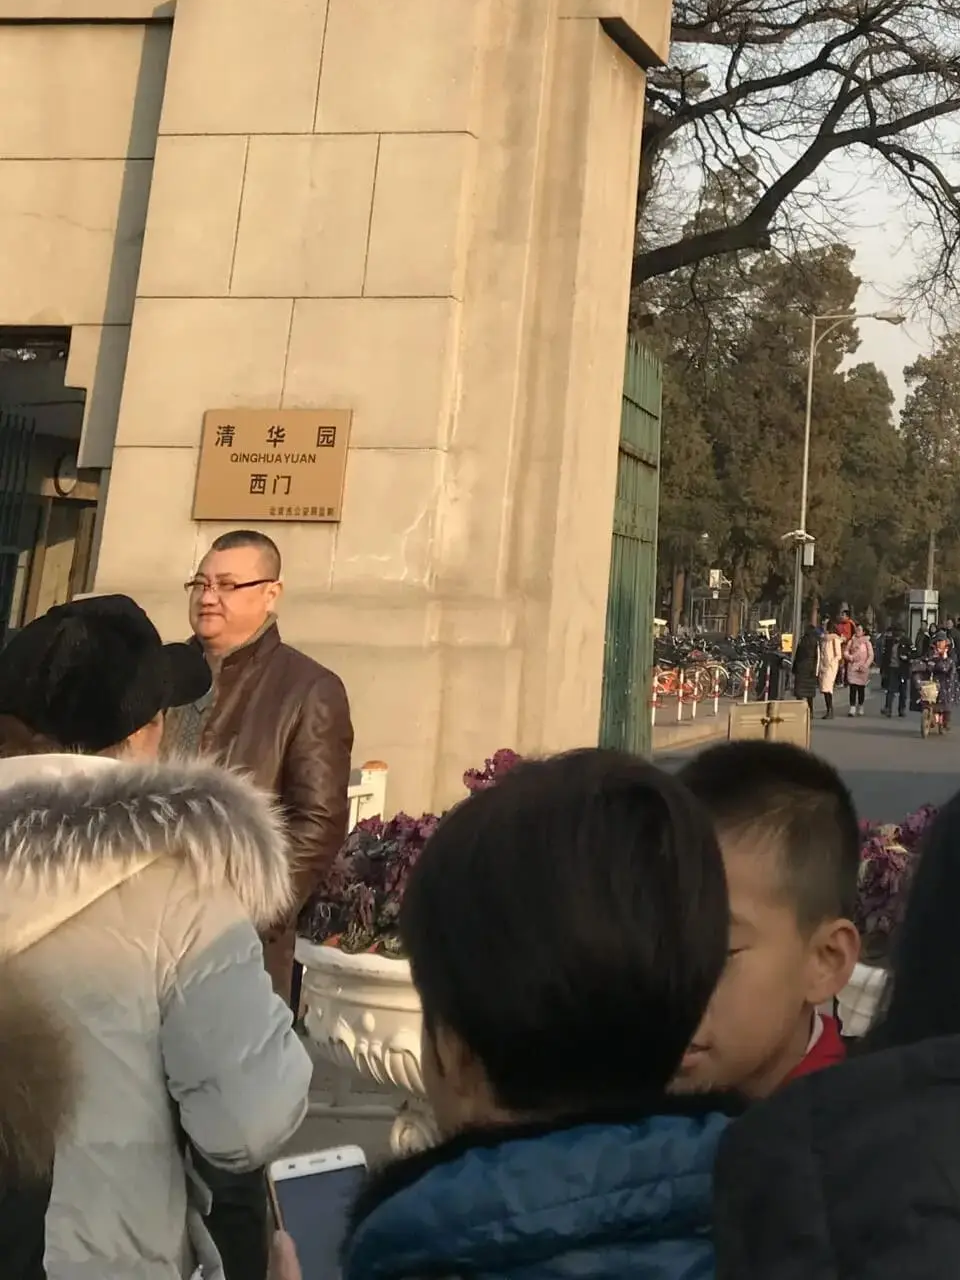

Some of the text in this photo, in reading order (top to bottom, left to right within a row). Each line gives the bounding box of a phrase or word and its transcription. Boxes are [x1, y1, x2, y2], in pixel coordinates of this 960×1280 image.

[215, 425, 337, 448] 清华园
[250, 474, 292, 495] 西门
